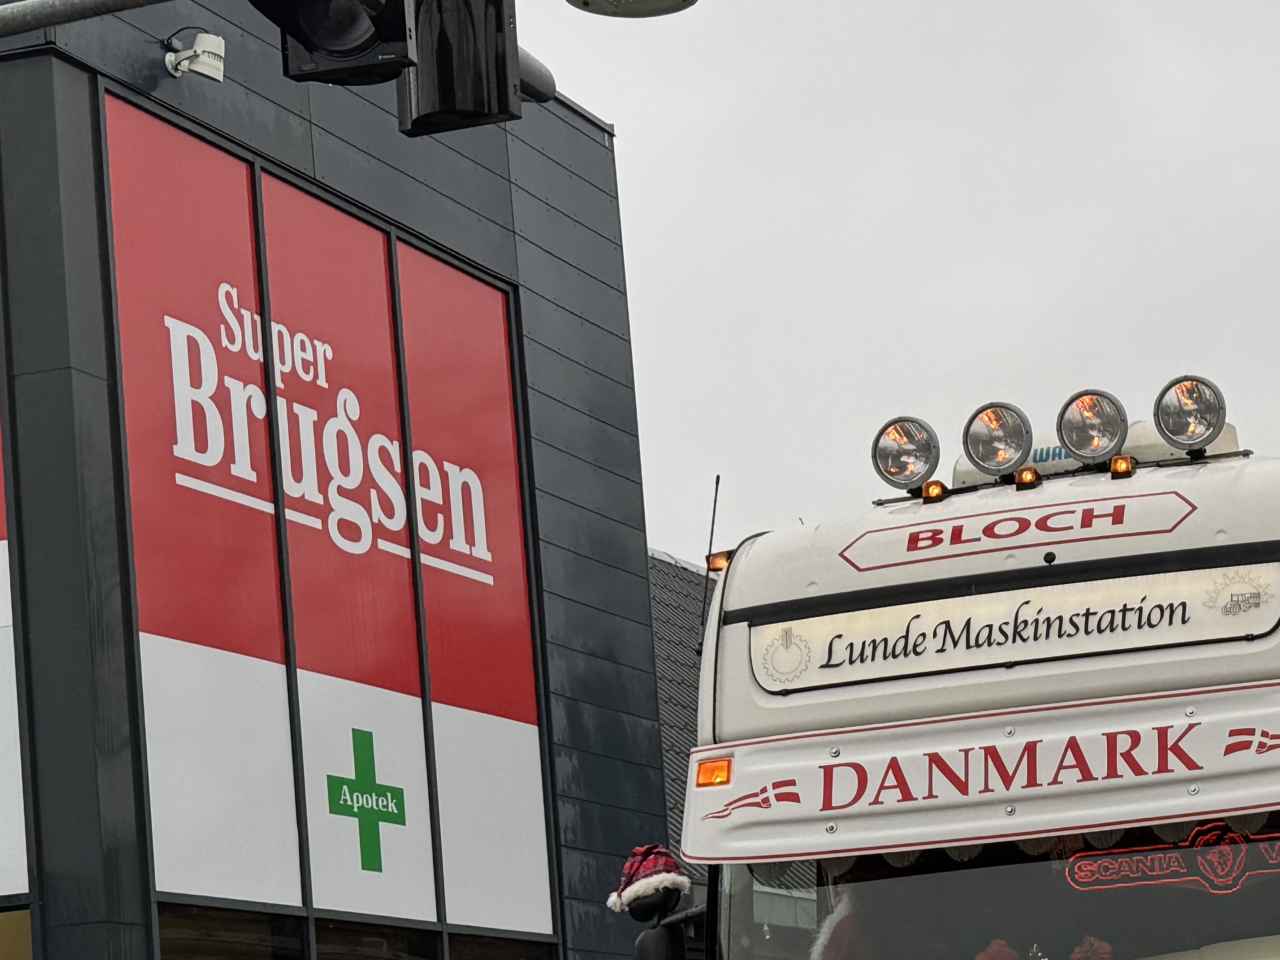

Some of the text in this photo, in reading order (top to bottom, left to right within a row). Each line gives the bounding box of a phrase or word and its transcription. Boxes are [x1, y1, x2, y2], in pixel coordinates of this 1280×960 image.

[218, 282, 334, 390] Super
[163, 314, 493, 562] Brugsen
[906, 504, 1126, 552] BLOCH
[818, 594, 1190, 670] Lunde Maskinstation
[339, 785, 398, 813] Apotek
[818, 722, 1204, 812] DANMARK
[1074, 853, 1188, 882] SCANIA
